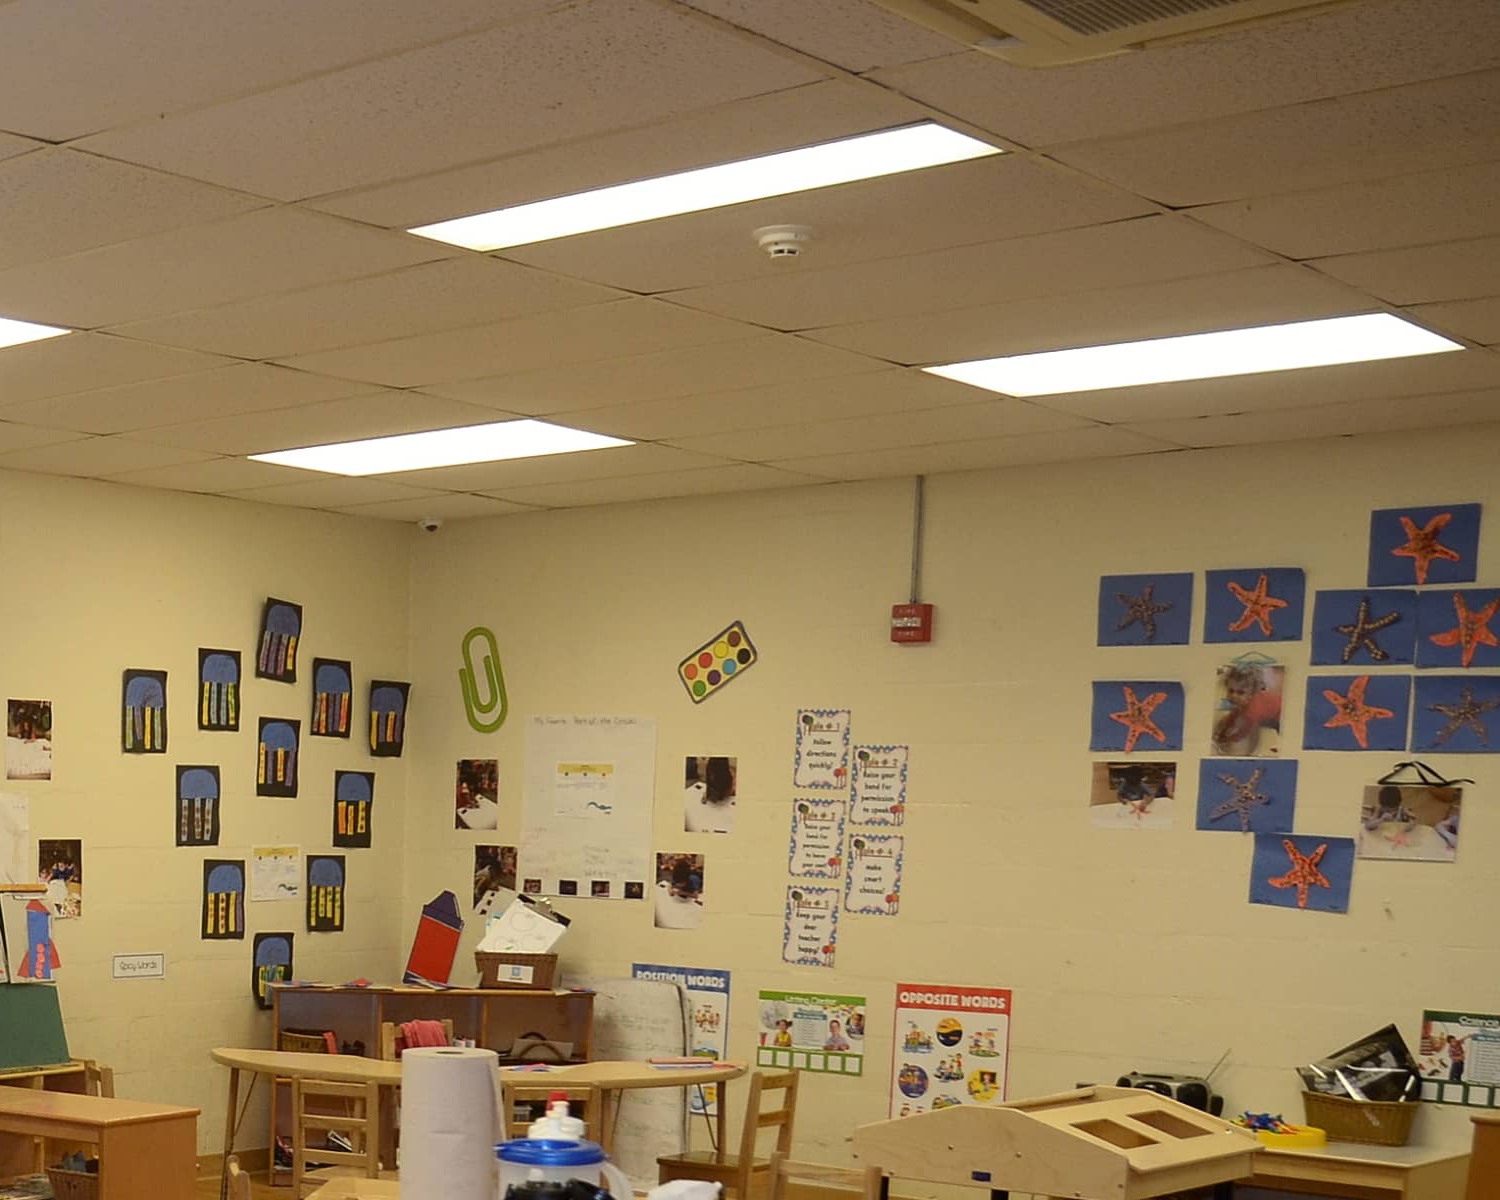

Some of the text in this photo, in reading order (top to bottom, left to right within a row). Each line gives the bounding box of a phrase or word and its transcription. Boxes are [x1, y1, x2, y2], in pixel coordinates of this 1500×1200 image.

[636, 970, 725, 988] POSITION WORDS
[900, 992, 1005, 1009] OPPOSITE WORDS
